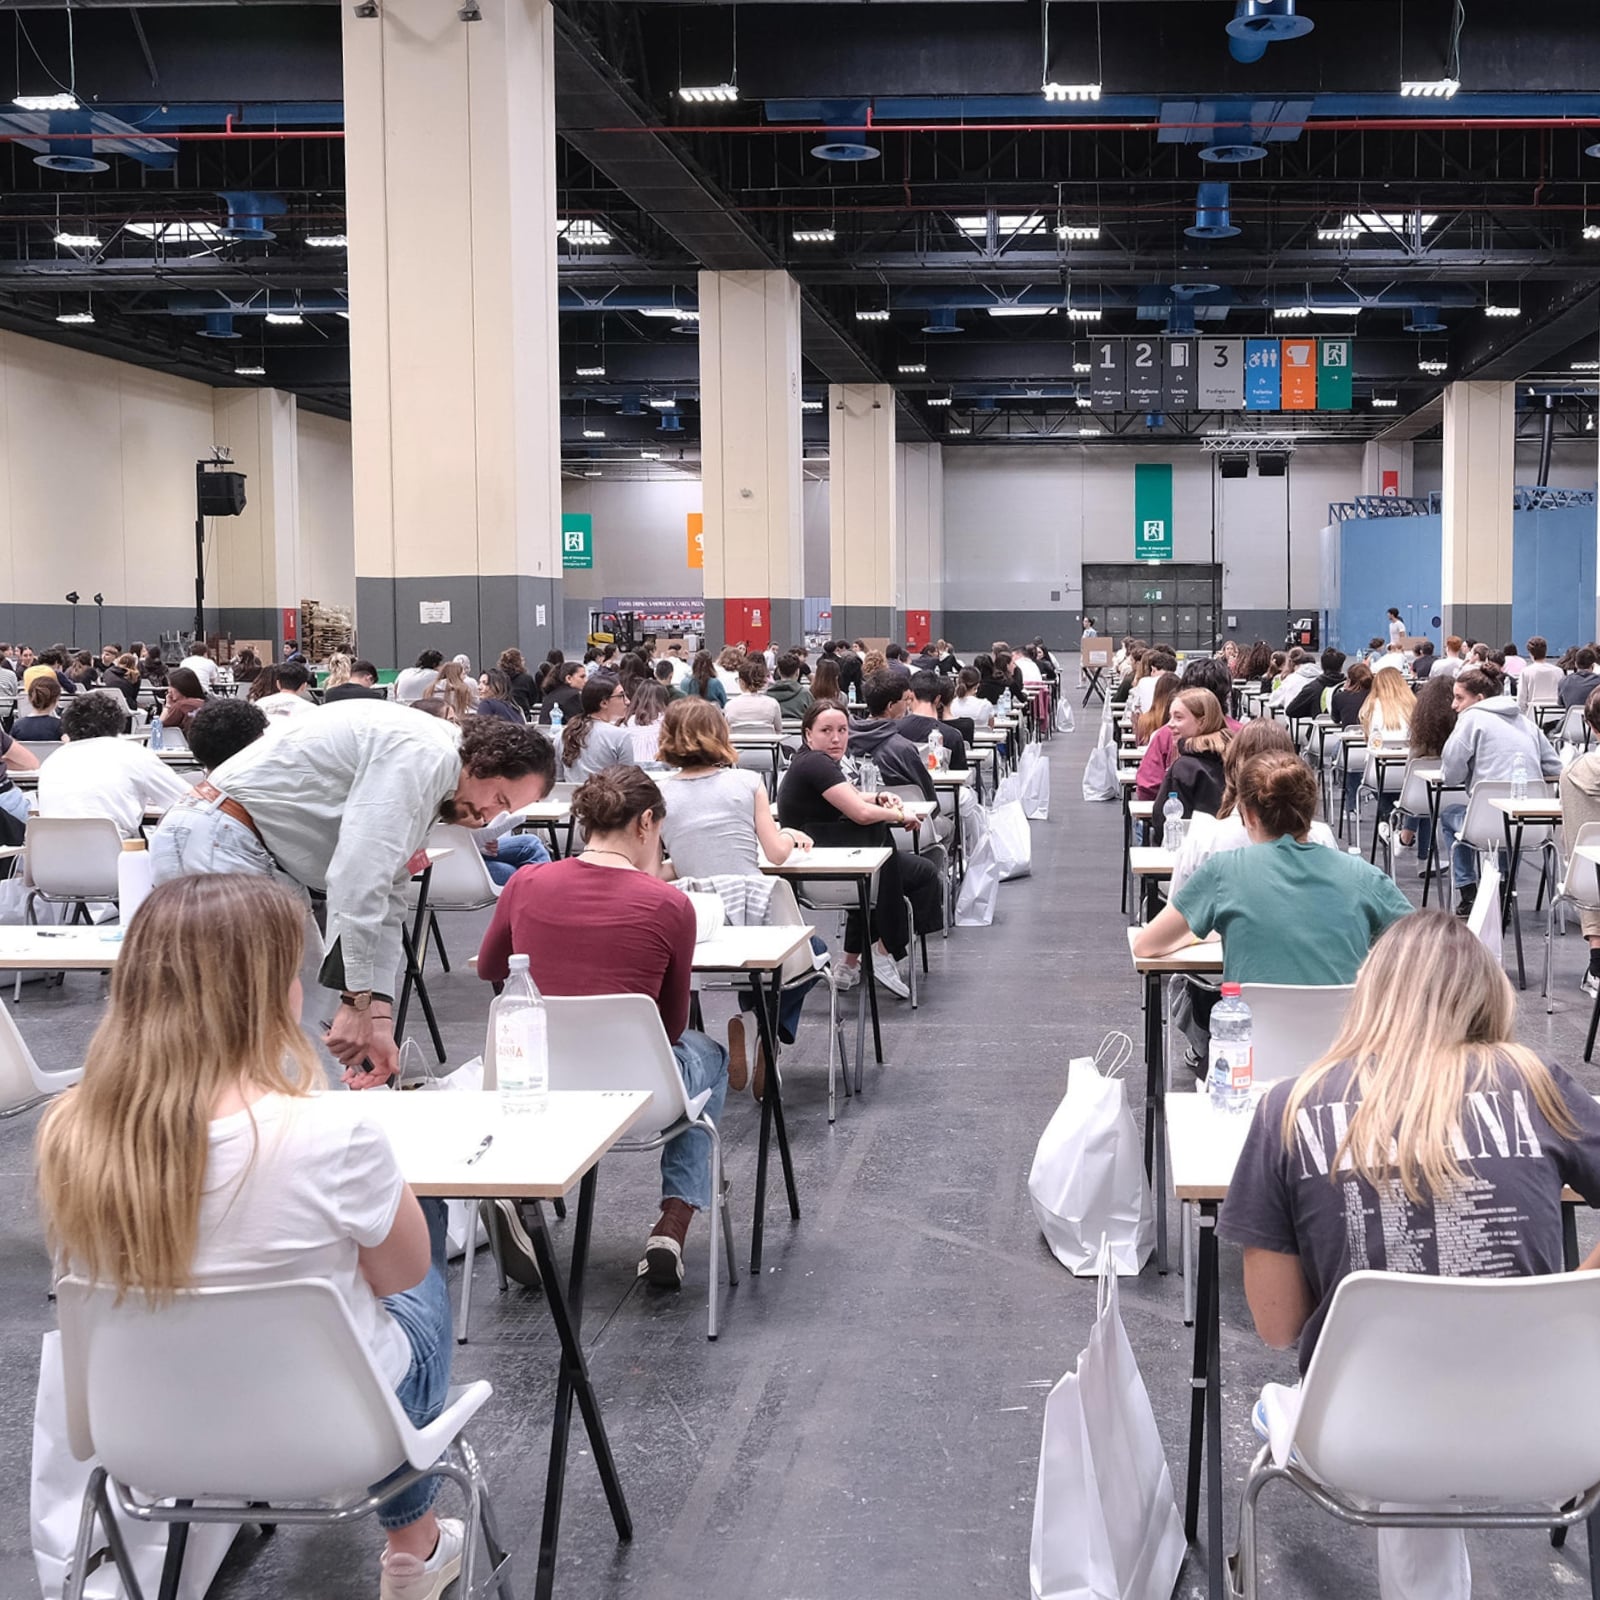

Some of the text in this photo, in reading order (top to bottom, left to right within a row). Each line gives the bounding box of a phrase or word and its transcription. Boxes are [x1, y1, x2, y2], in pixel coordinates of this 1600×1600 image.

[1100, 344, 1115, 368] 1
[1135, 343, 1153, 367] 2
[1213, 345, 1228, 367] 3
